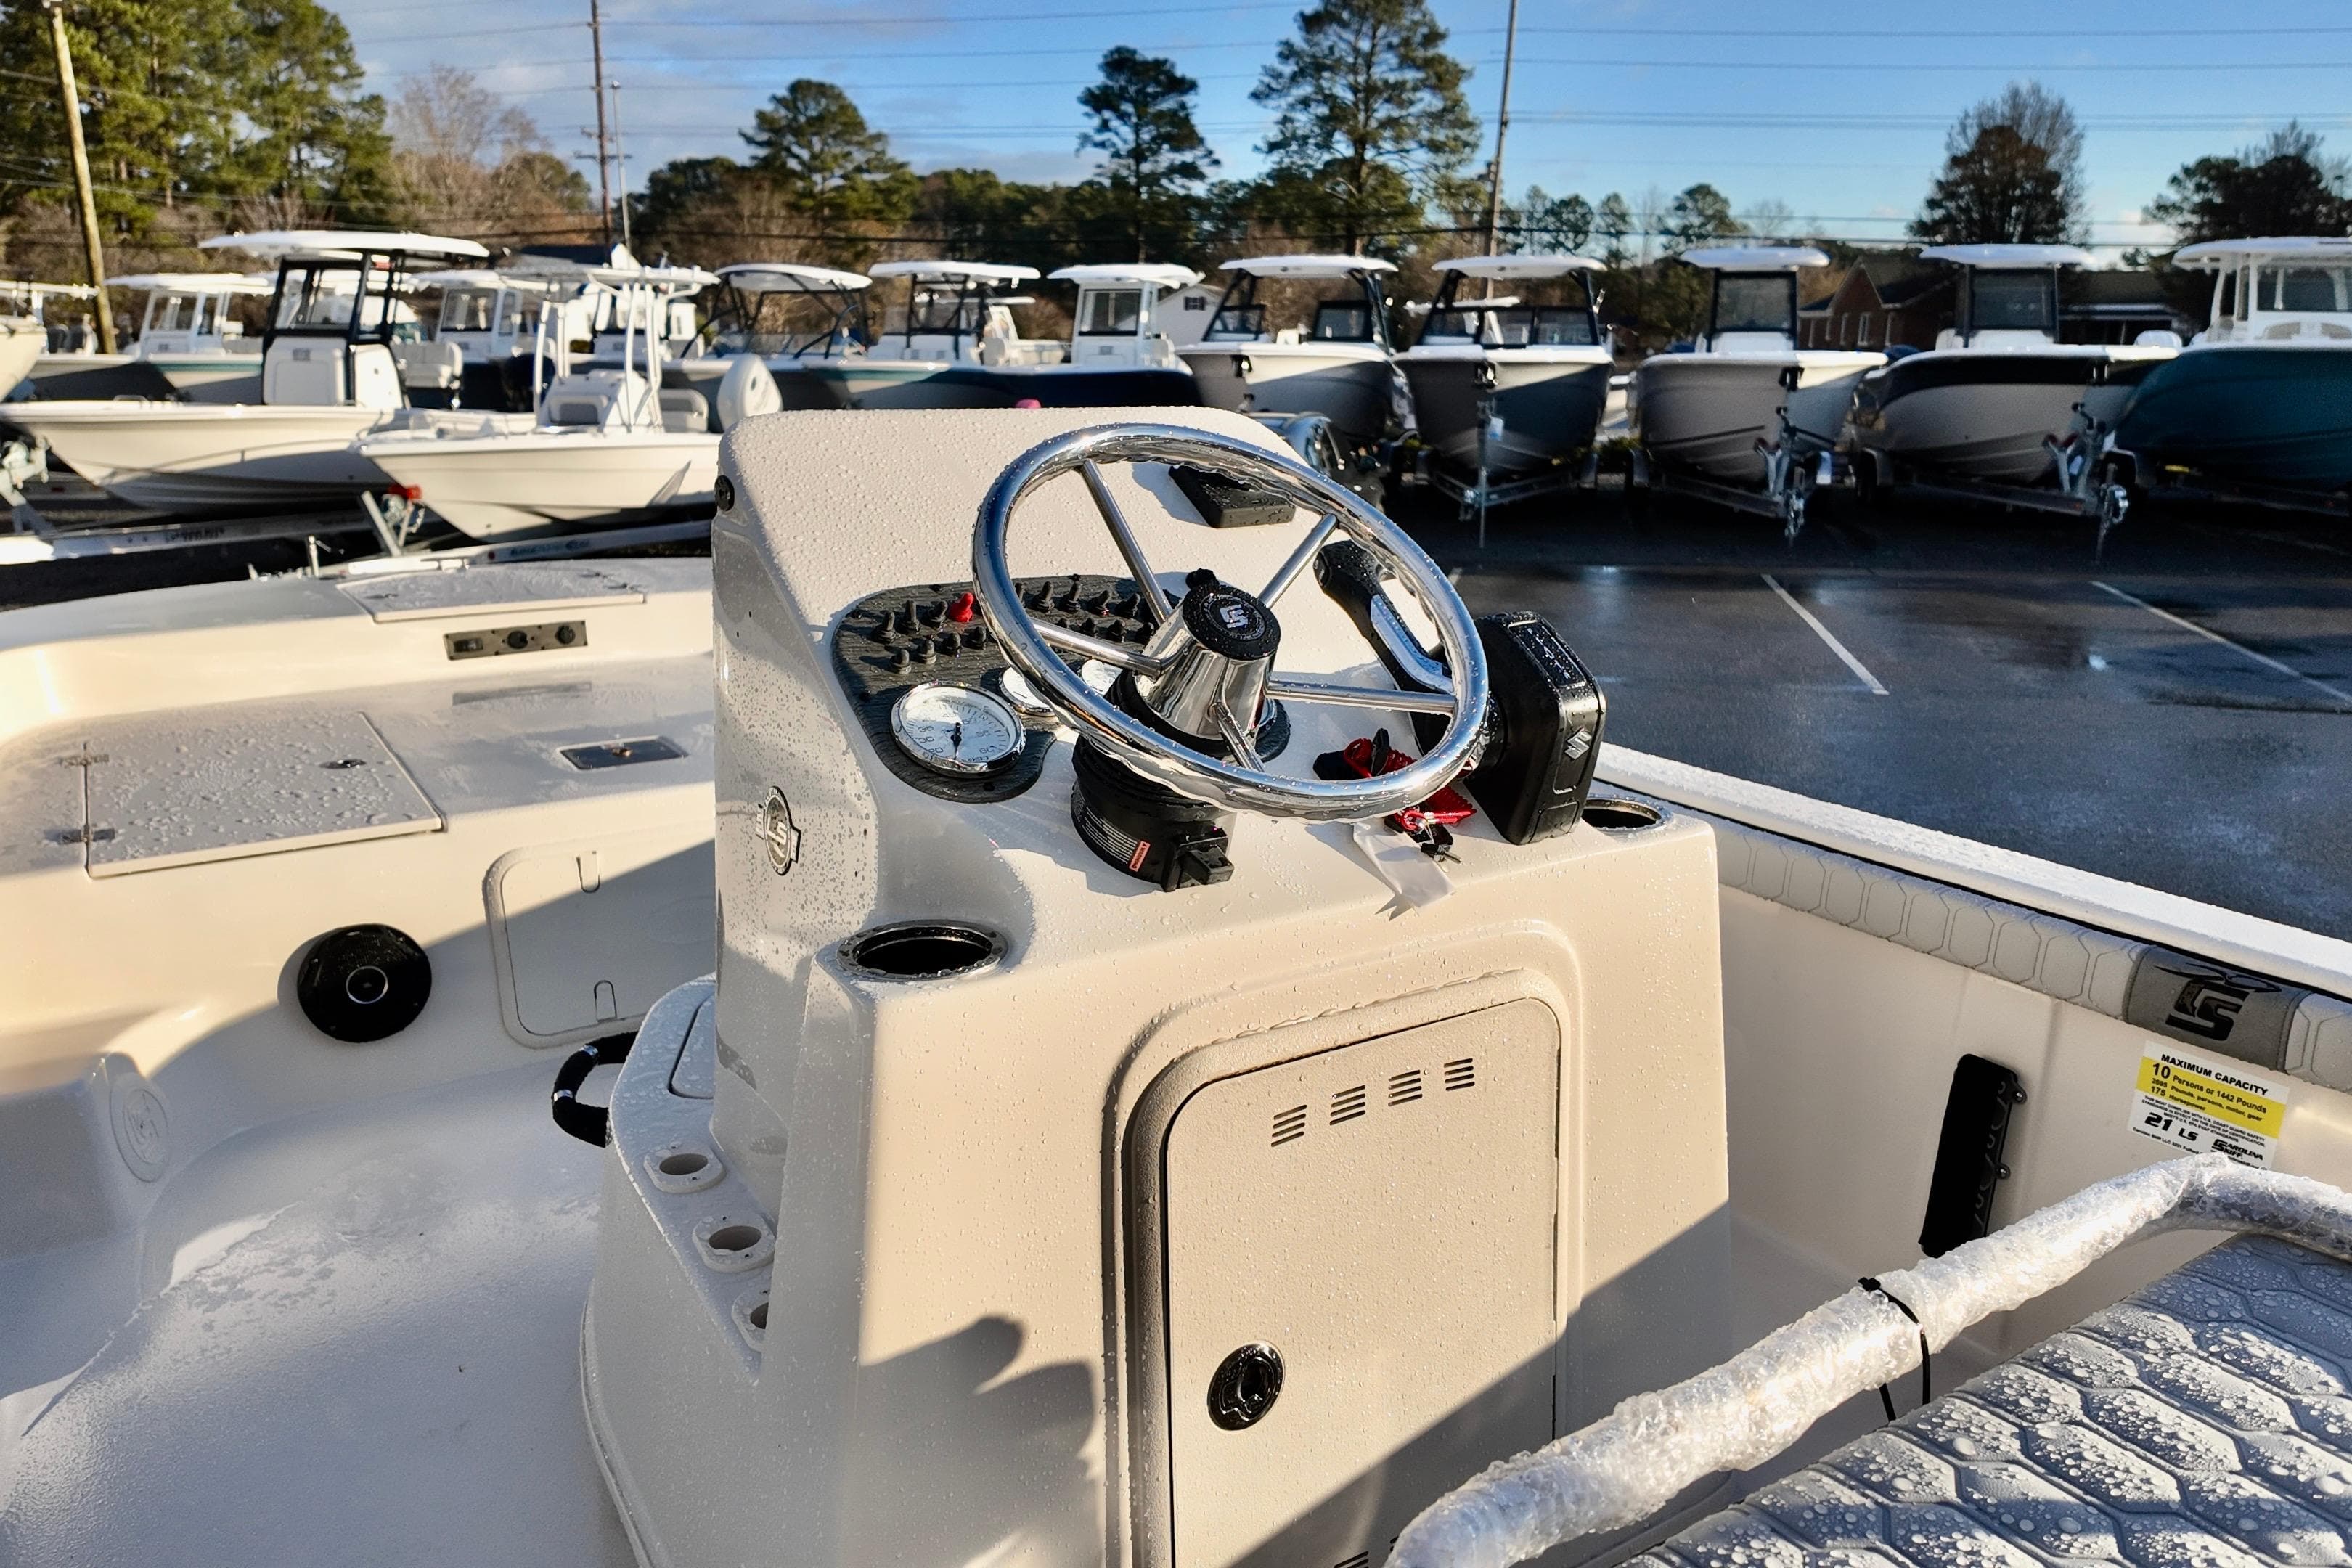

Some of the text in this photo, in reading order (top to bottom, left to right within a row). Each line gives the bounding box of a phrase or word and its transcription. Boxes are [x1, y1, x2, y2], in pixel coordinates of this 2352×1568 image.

[2152, 1063, 2171, 1079] 10
[2173, 1075, 2204, 1092] Persons
[2217, 1090, 2235, 1102] 1442
[2236, 1097, 2266, 1114] Pounds
[2161, 1054, 2269, 1095] MAXIMUM CAPACITY
[2151, 1086, 2166, 1097] 175
[2144, 1112, 2199, 1141] 21 LS
[2213, 1138, 2263, 1161] CAROLINA
